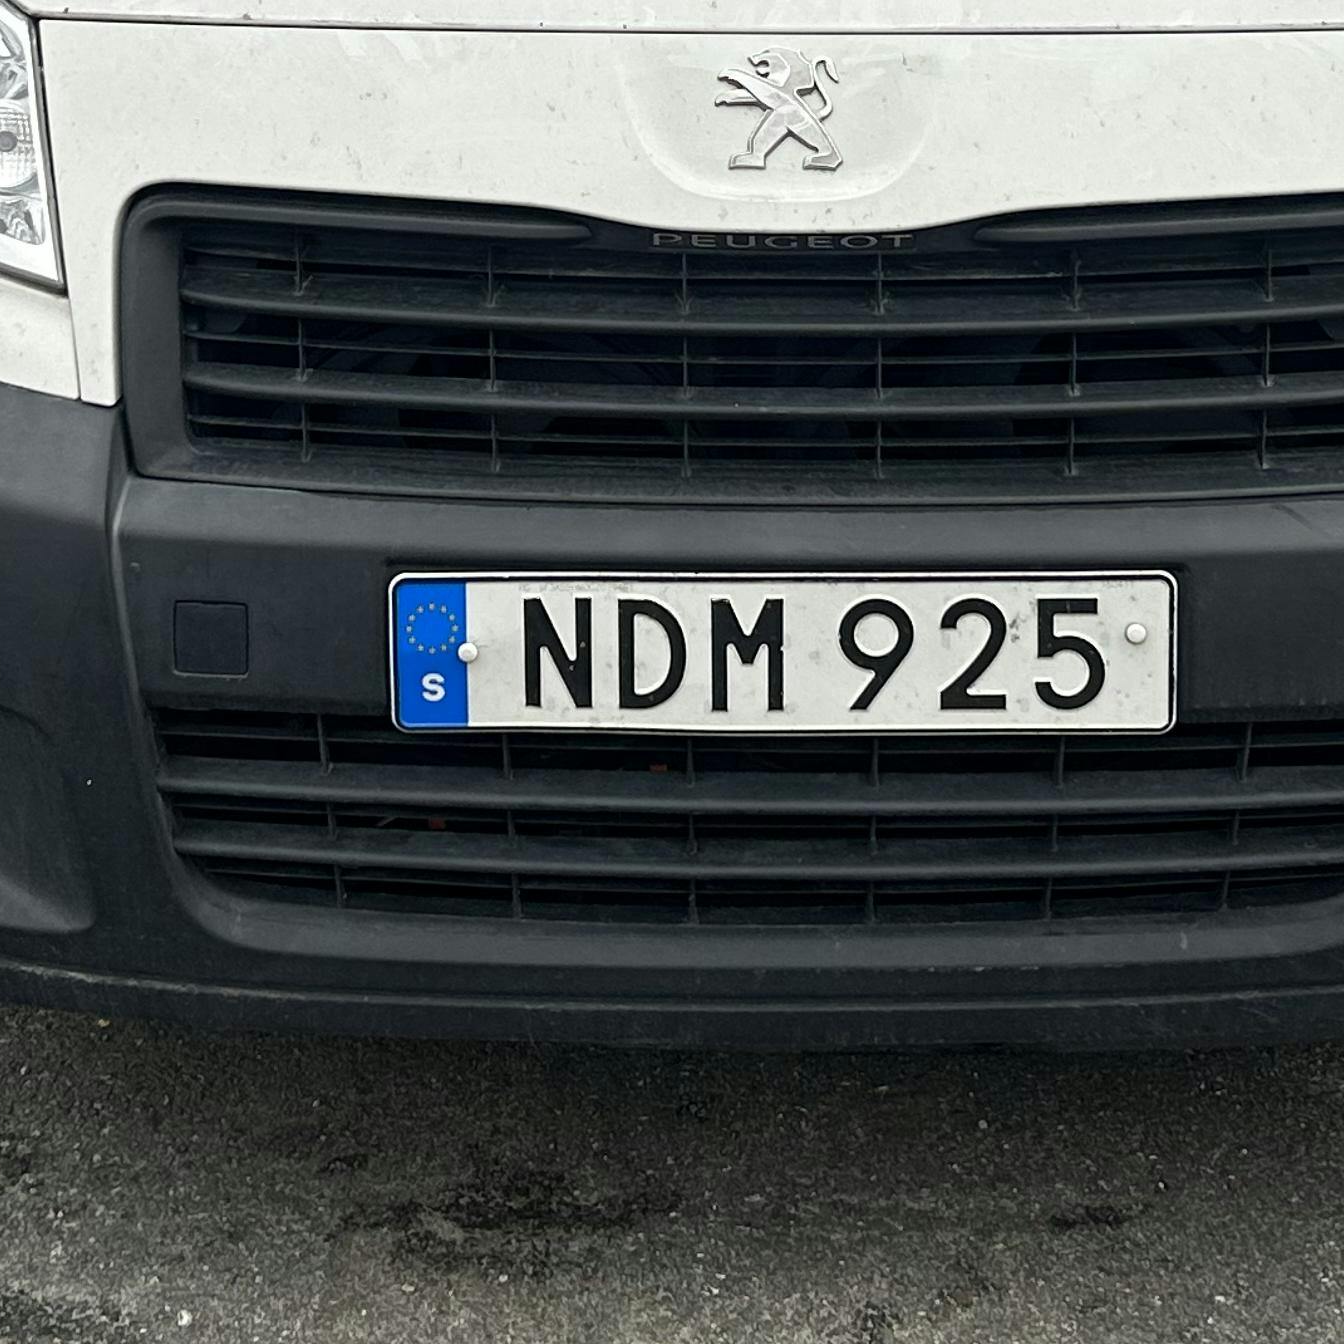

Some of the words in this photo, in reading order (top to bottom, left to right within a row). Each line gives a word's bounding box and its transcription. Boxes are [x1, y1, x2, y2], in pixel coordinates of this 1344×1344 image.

[652, 232, 913, 249] PEUGEOT
[523, 597, 785, 712] NDM
[838, 597, 1107, 711] 925
[420, 672, 447, 703] S
